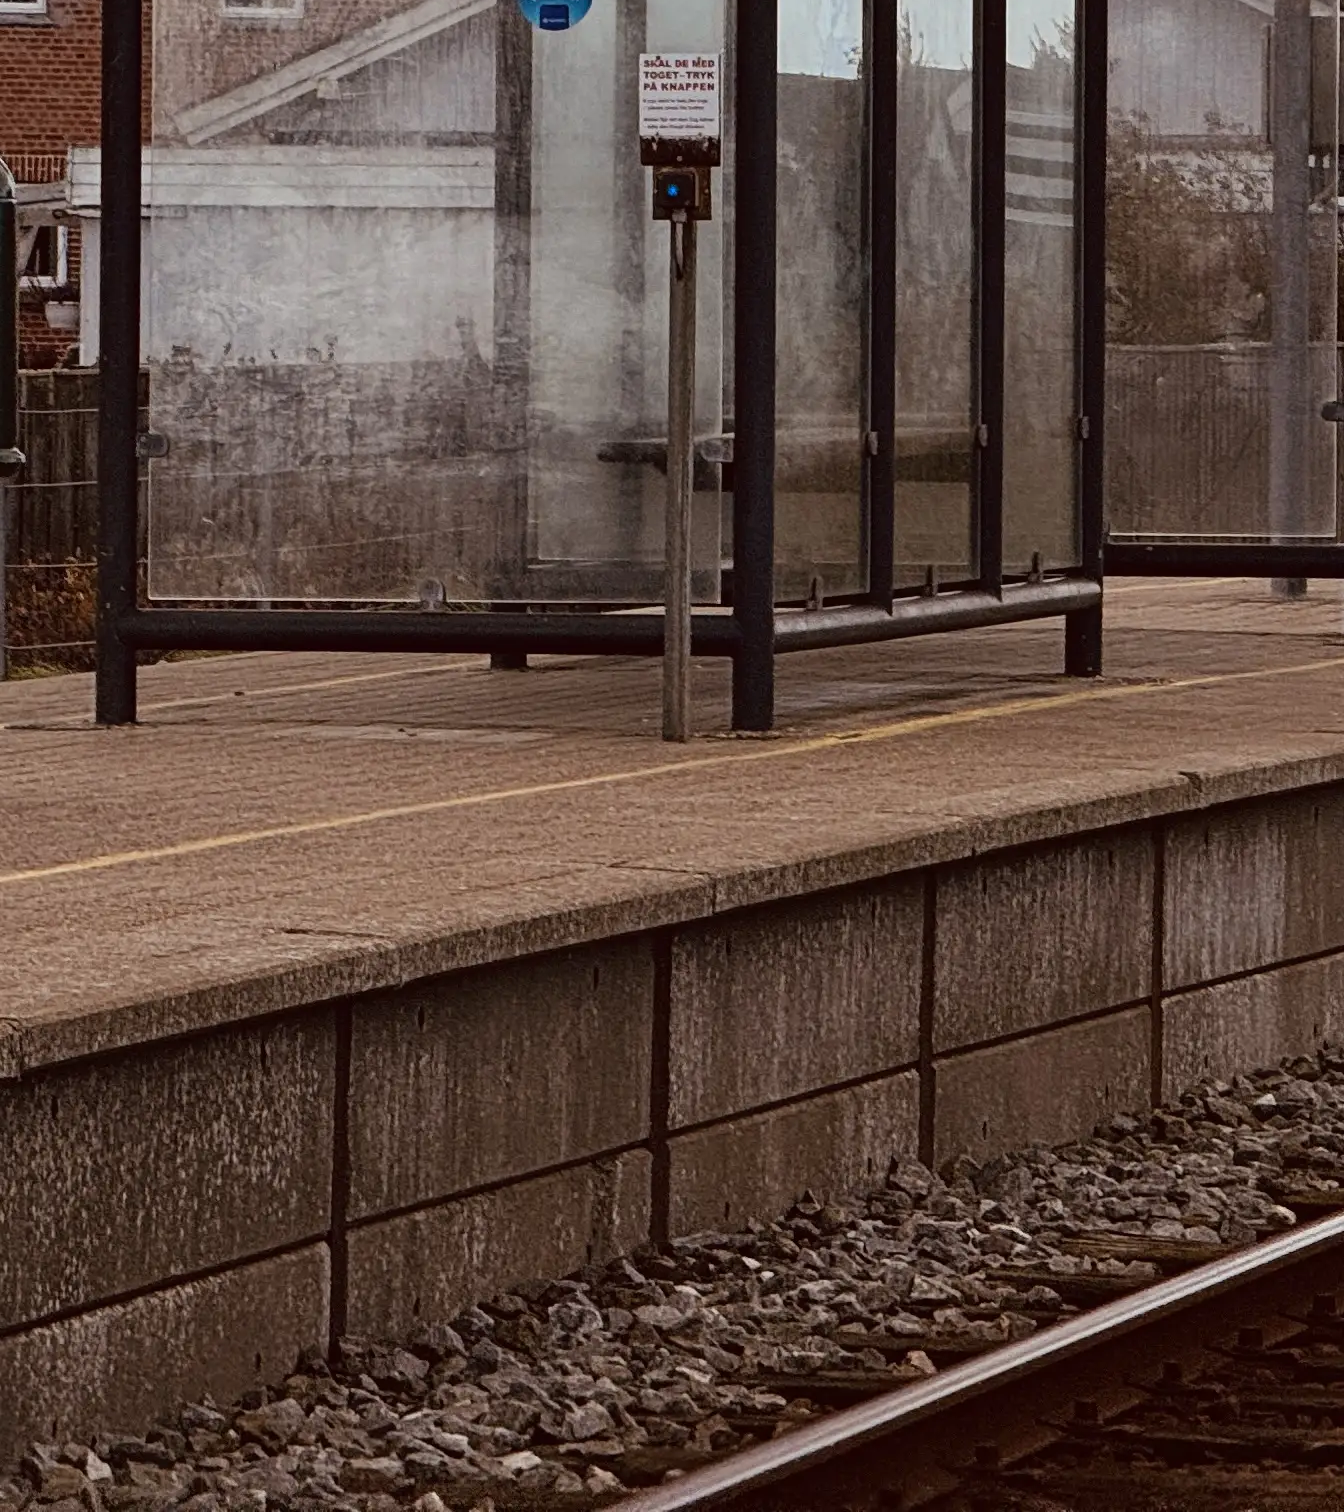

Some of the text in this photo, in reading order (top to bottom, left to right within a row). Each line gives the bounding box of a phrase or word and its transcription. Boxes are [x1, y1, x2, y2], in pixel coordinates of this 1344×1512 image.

[643, 60, 715, 68] SKAL DE MED
[643, 82, 714, 91] PÅ KNAPPEN
